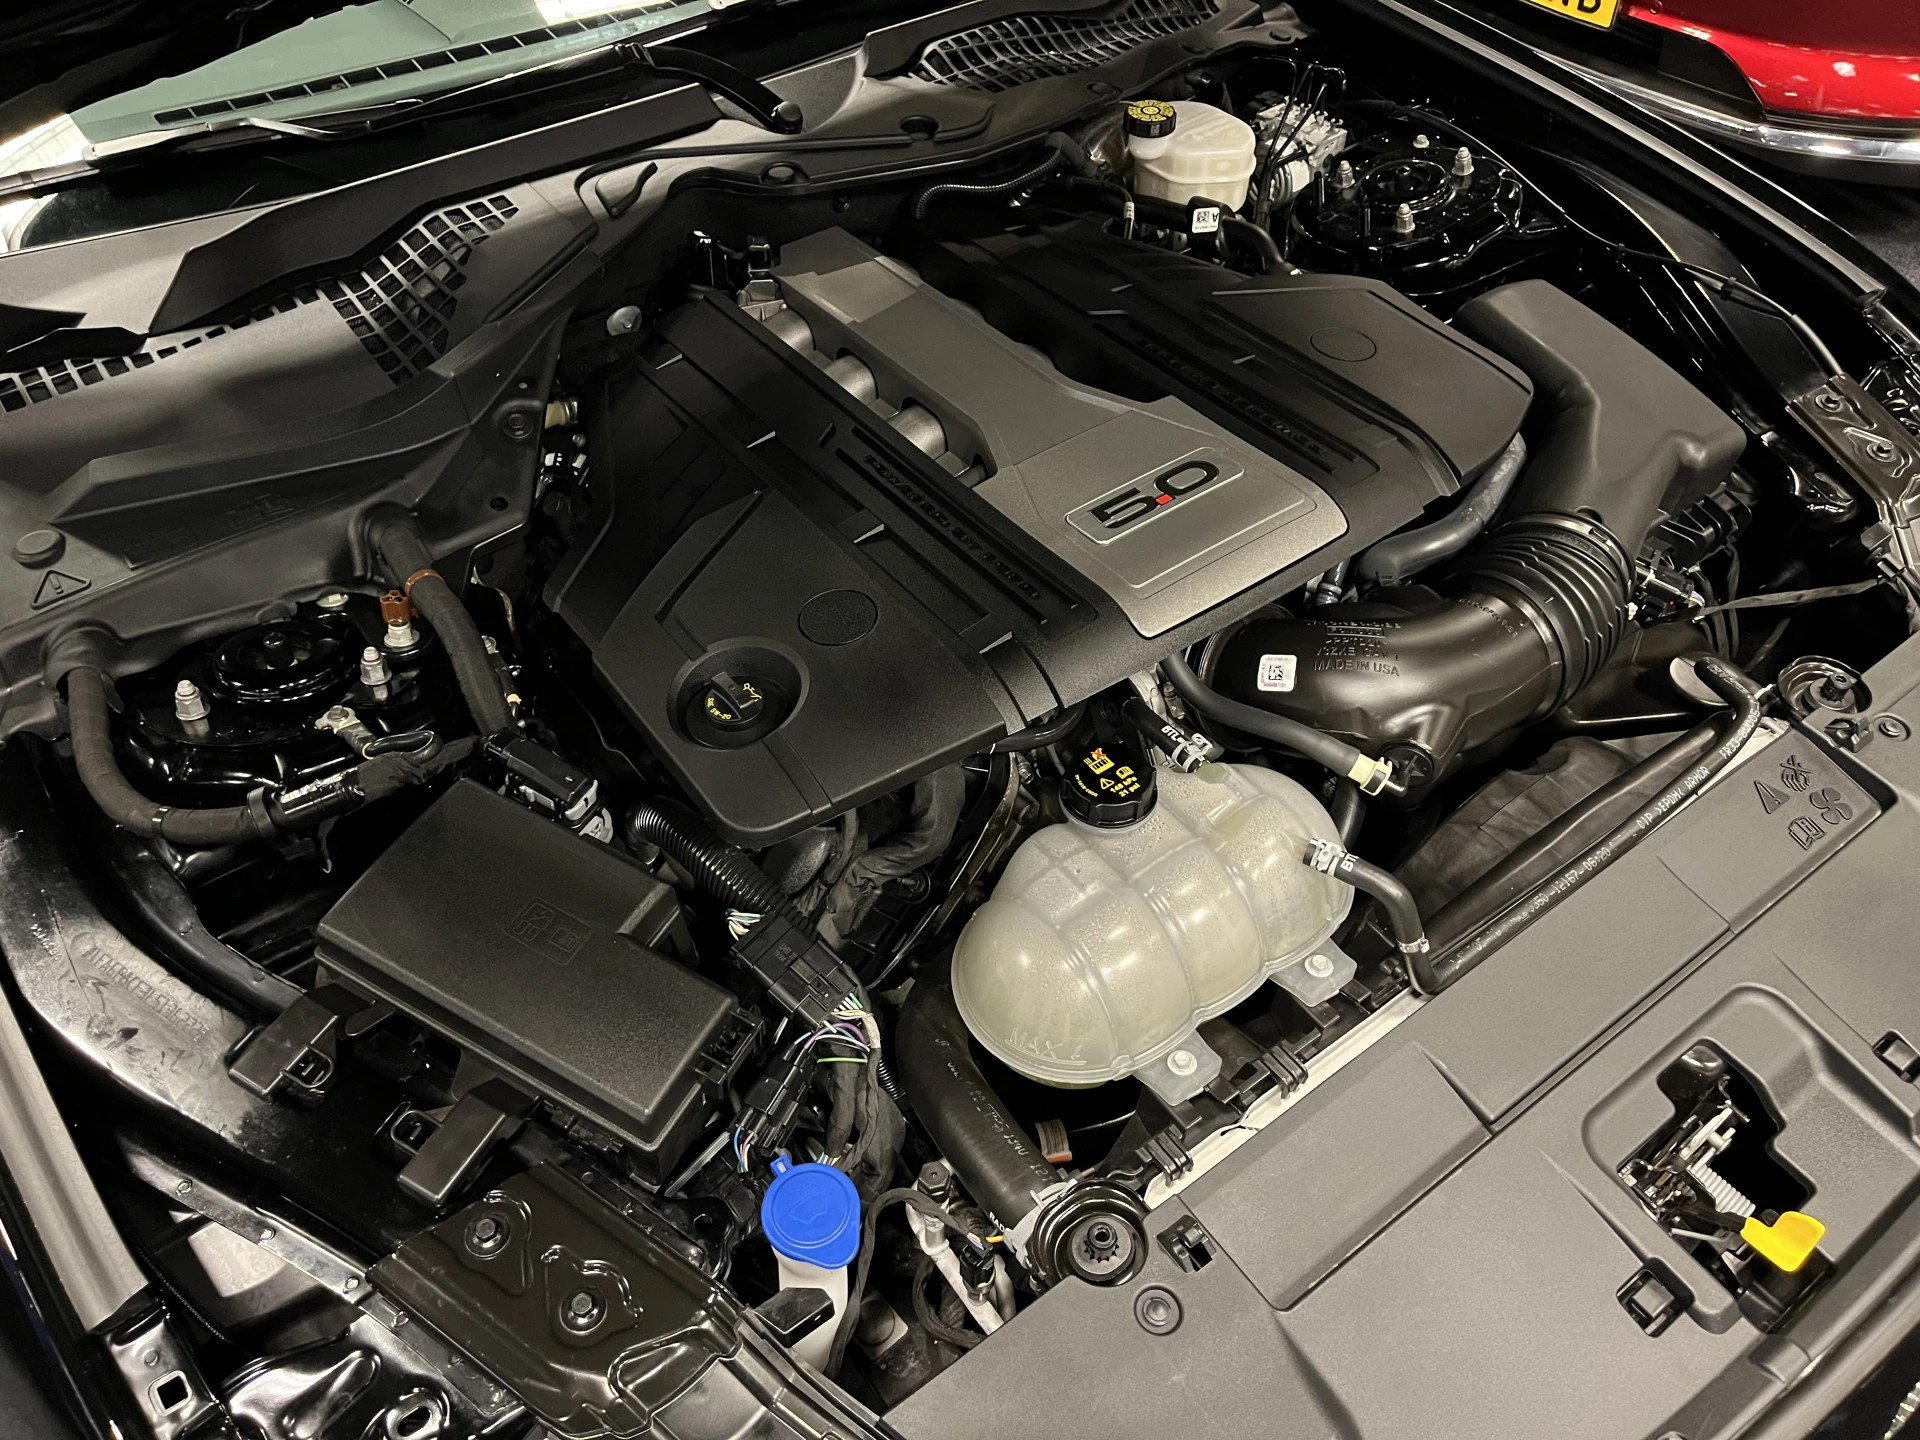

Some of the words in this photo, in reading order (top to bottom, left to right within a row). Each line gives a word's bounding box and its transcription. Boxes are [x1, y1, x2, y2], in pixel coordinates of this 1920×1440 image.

[1089, 460, 1220, 529] 5.0
[1314, 659, 1353, 671] MADE
[1356, 661, 1370, 671] IN
[1374, 662, 1400, 677] USA
[1684, 766, 1710, 790] ARMOR
[1009, 1027, 1064, 1059] MAX
